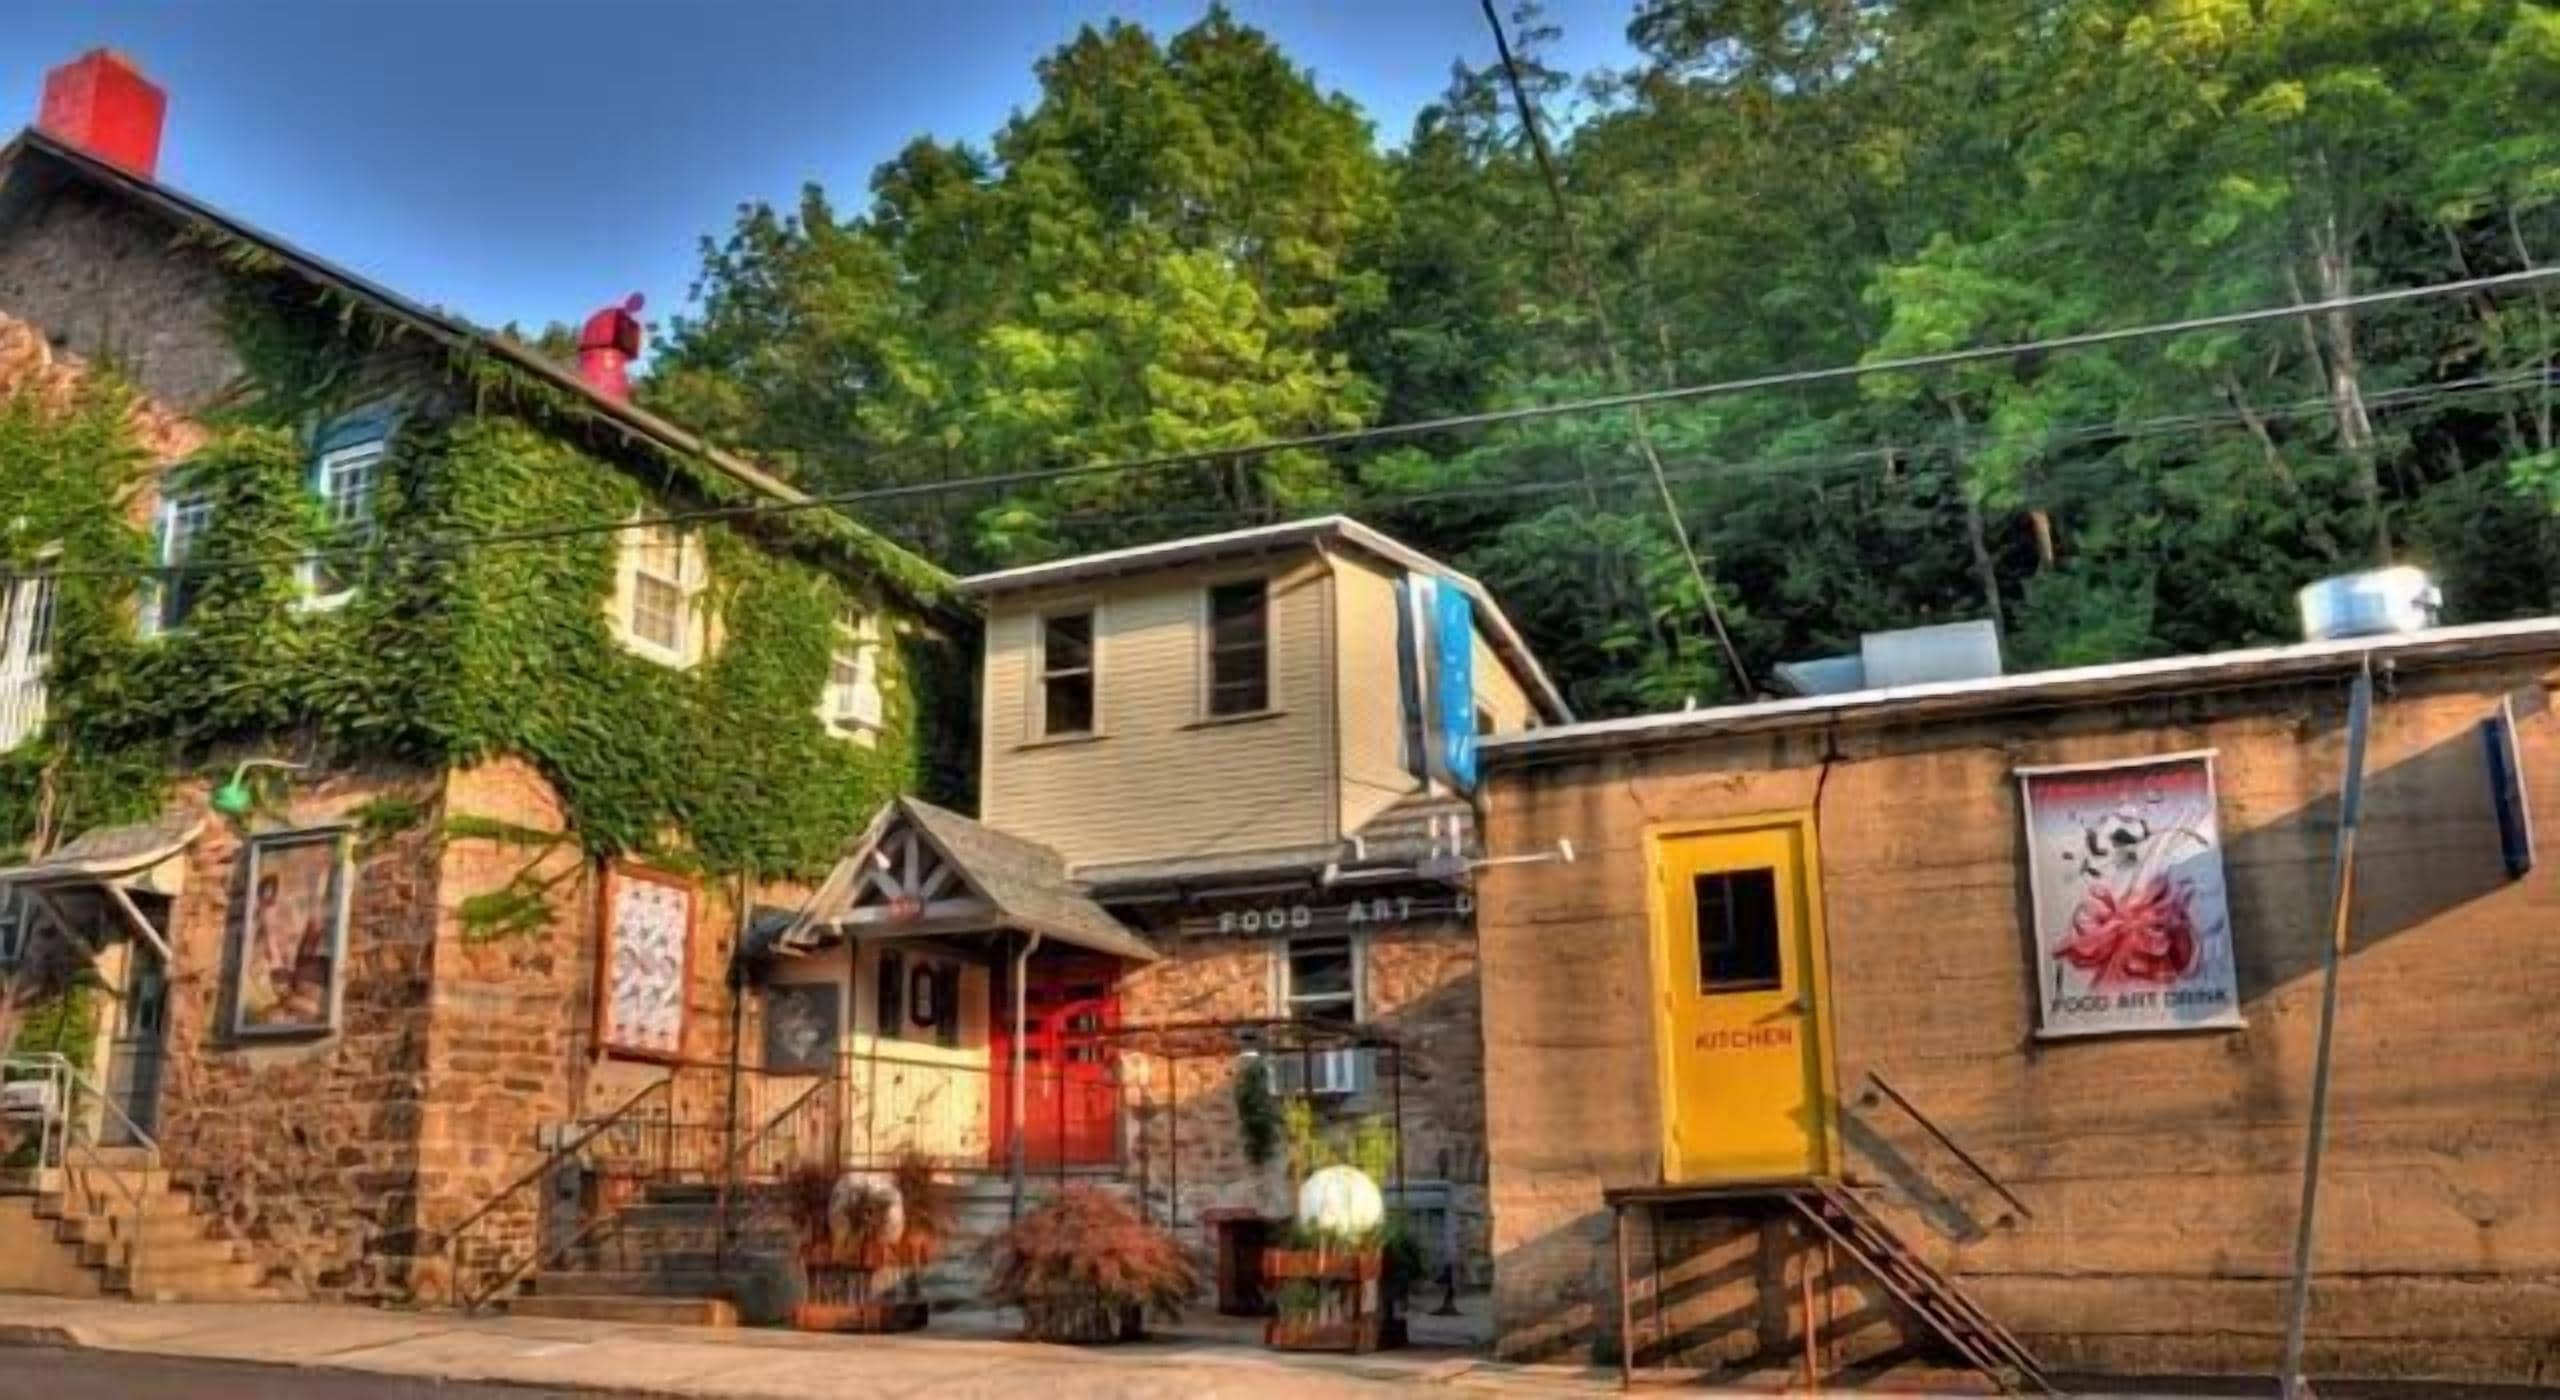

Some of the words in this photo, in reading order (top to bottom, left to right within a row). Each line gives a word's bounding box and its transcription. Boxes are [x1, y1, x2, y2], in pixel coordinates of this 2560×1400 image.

[1217, 905, 1311, 933] FOOD
[1347, 896, 1411, 922] ART
[1695, 1027, 1793, 1050] KITCHEN
